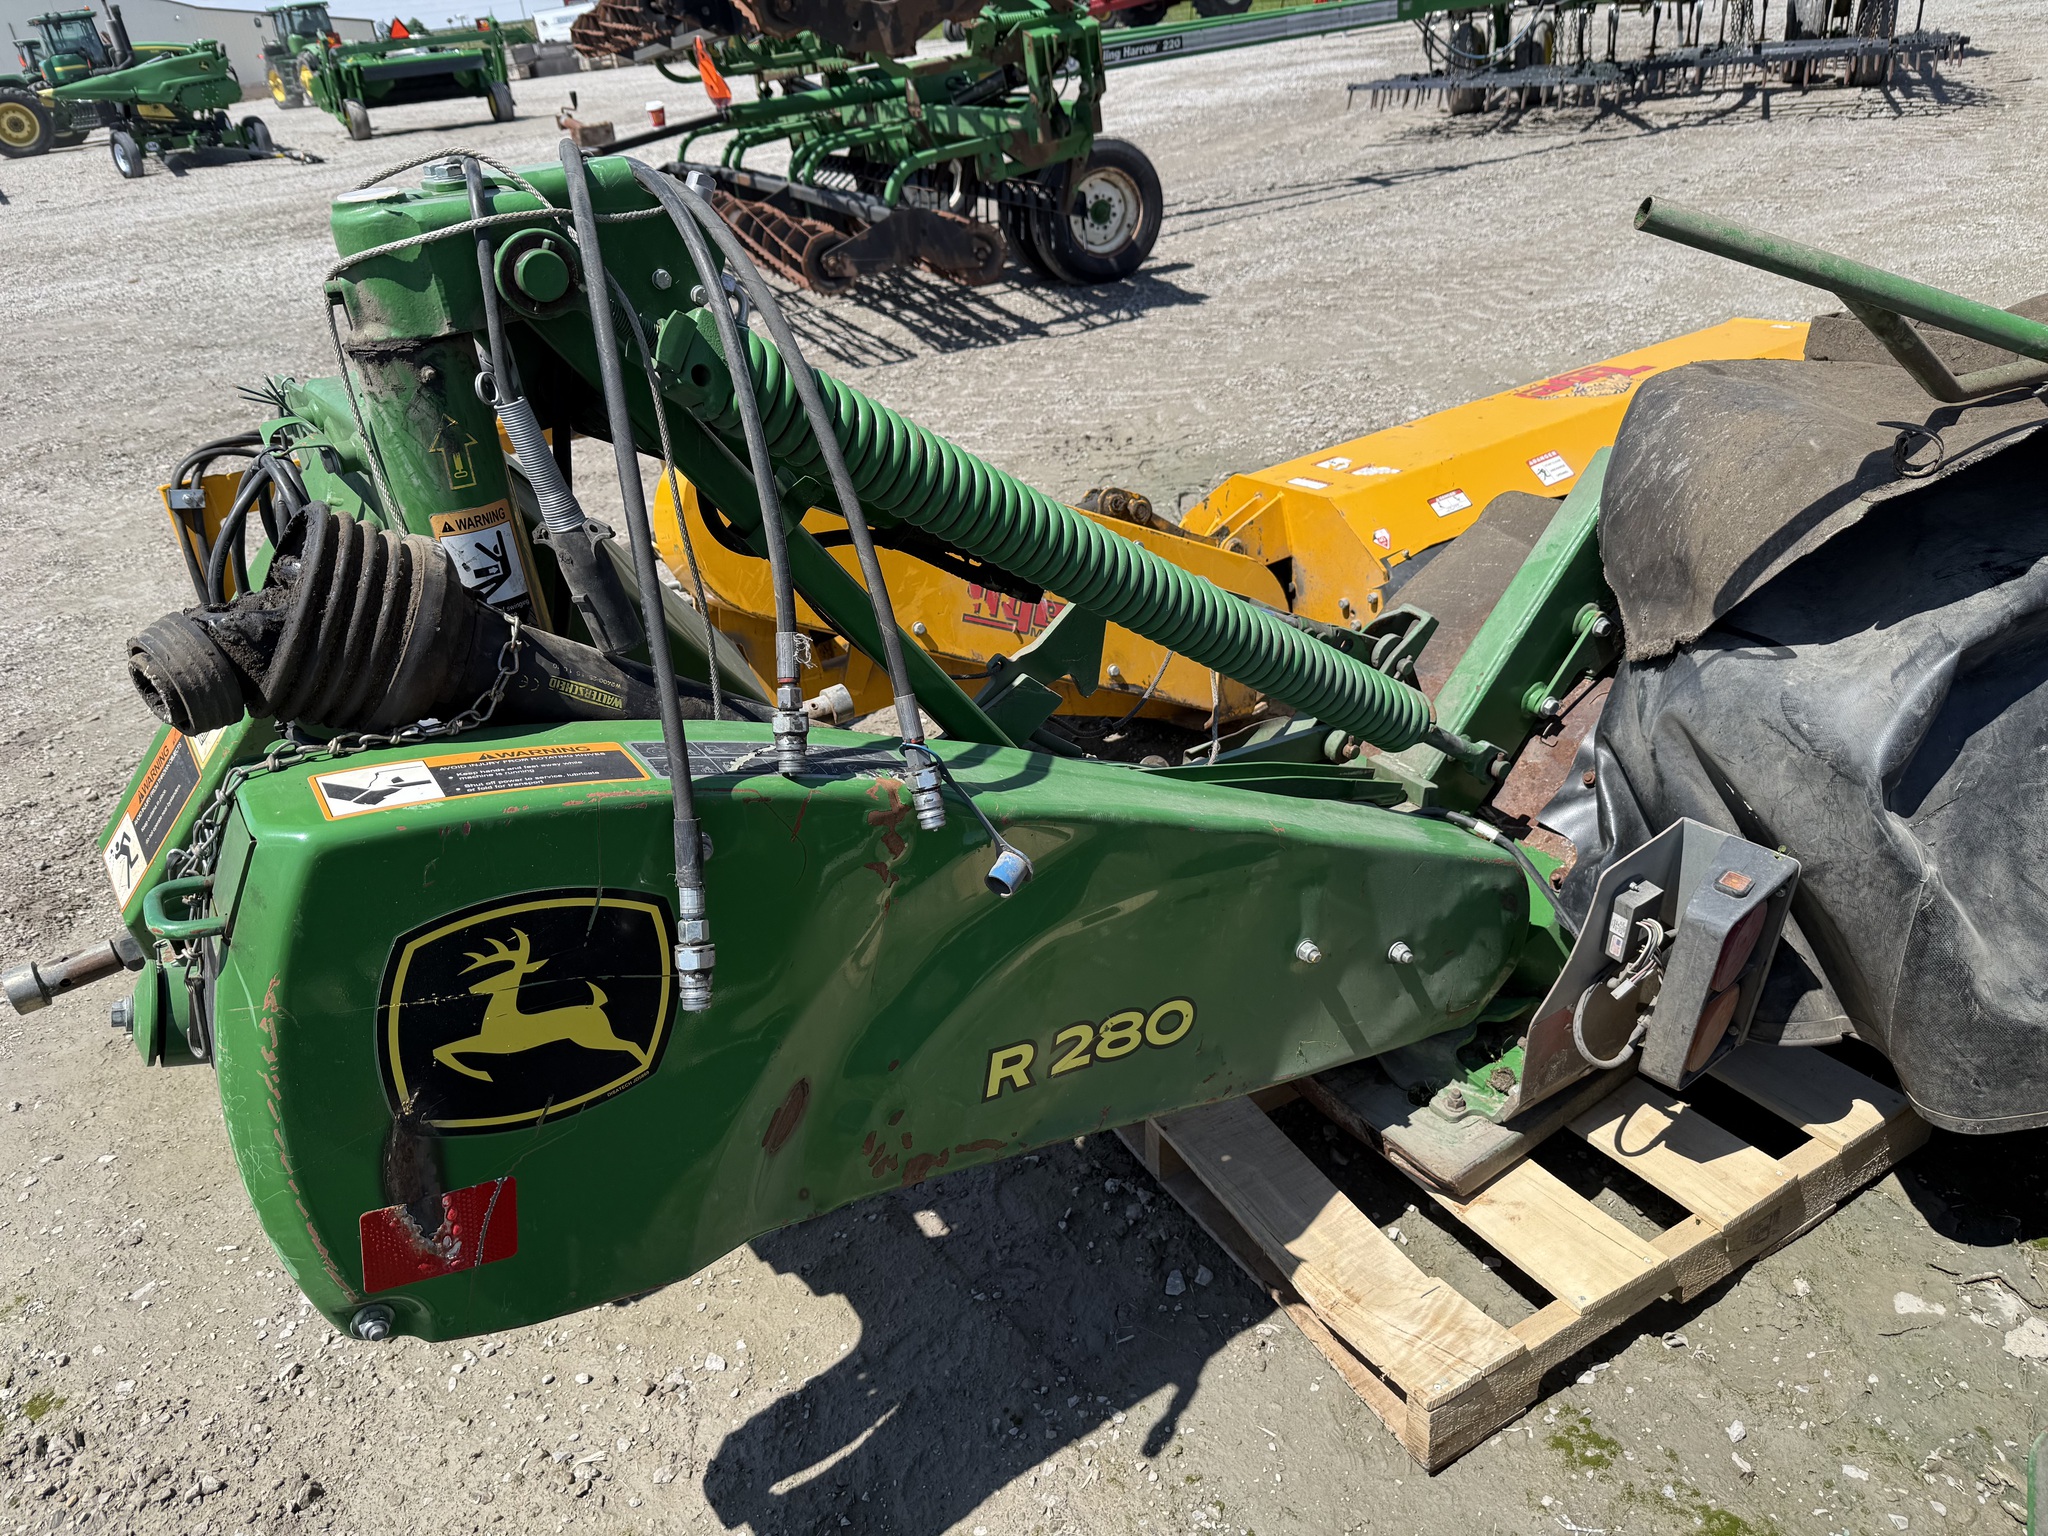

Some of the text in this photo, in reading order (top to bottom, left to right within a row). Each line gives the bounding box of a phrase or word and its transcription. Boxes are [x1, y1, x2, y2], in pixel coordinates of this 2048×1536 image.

[1103, 38, 1181, 61] ling Harrow 220
[455, 508, 506, 531] WARNING
[506, 599, 530, 612] swinging
[549, 678, 623, 709] WALTERSCHEID
[468, 760, 501, 768] INJURY
[495, 746, 591, 759] WARNING
[142, 745, 170, 794] WARNING
[507, 779, 544, 787] transport
[984, 997, 1196, 1101] R 280
